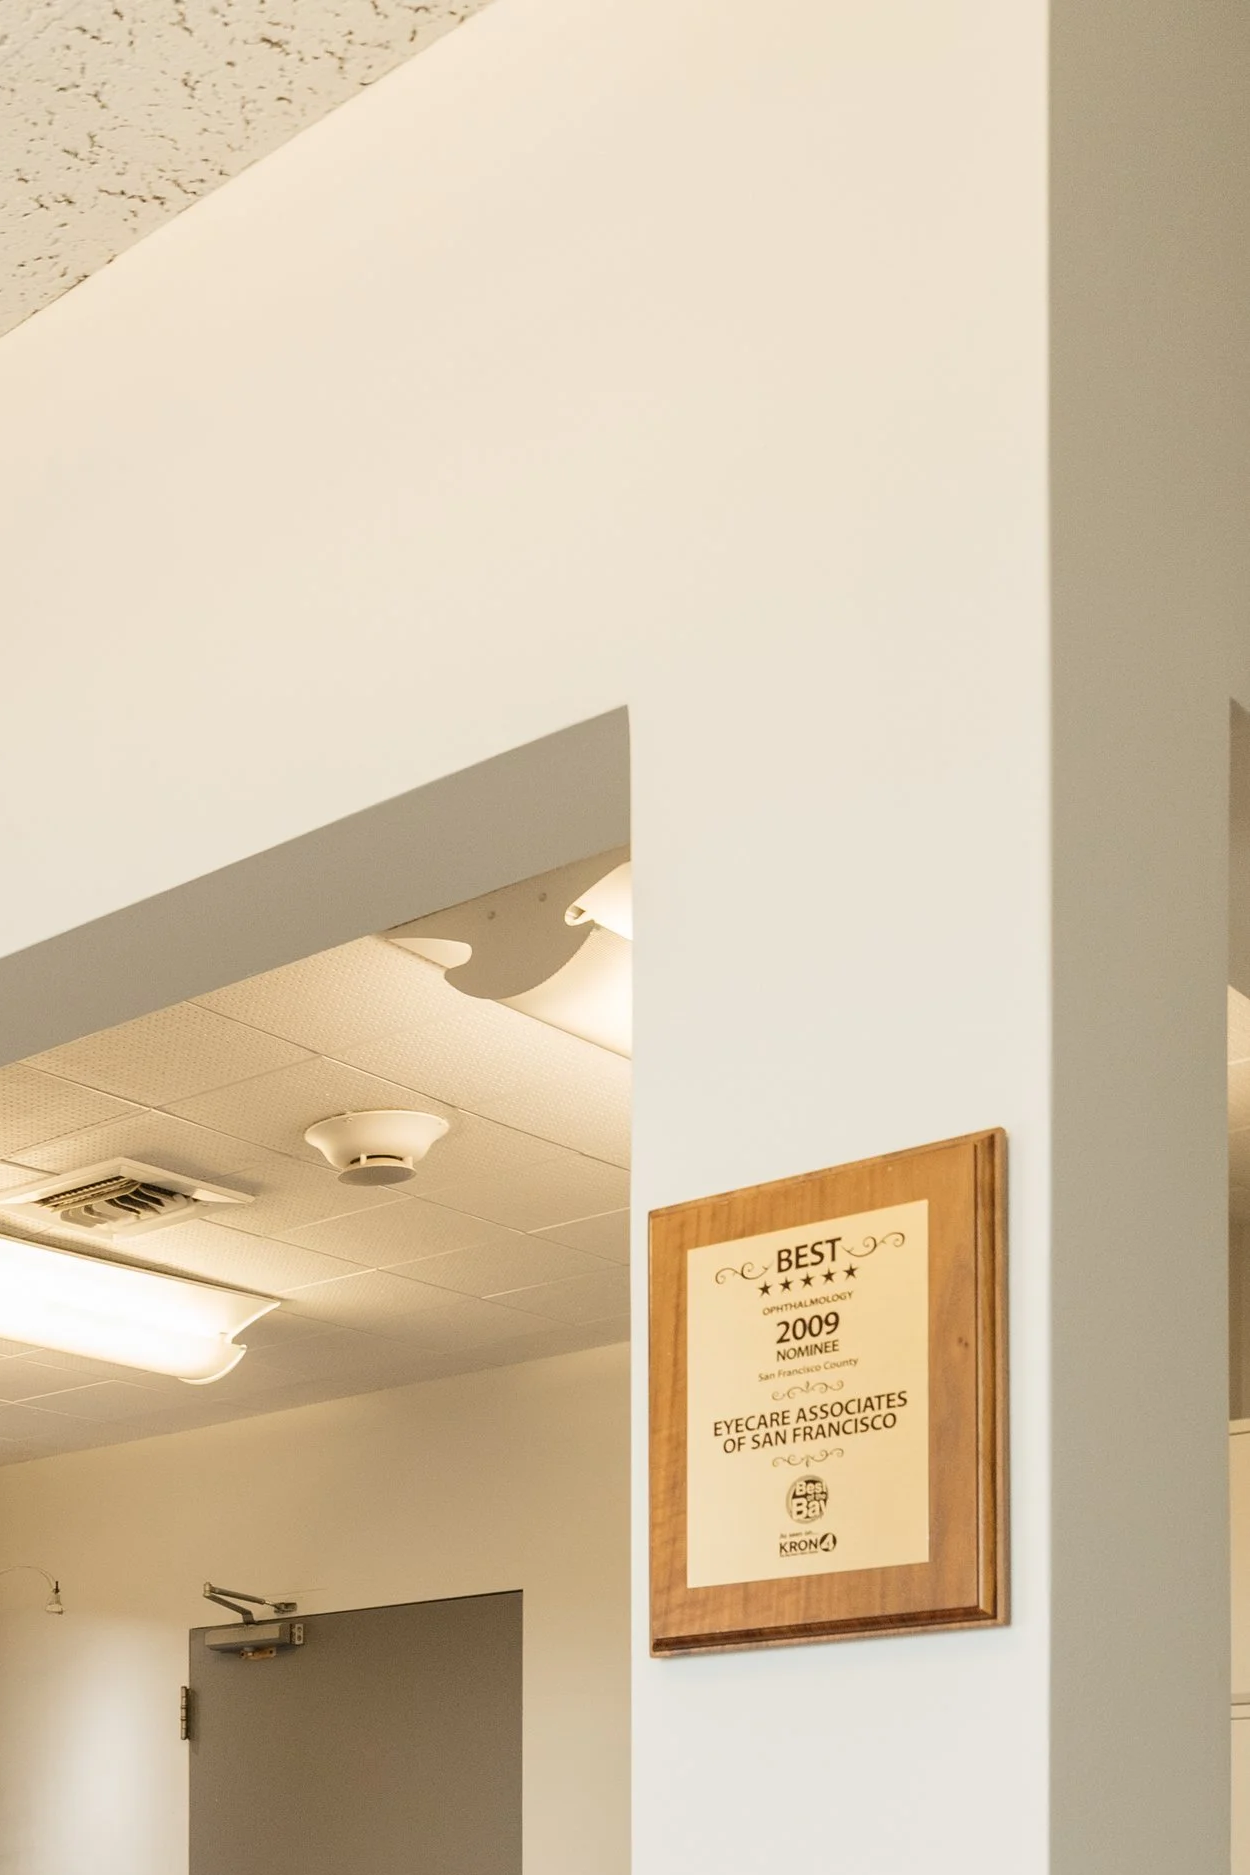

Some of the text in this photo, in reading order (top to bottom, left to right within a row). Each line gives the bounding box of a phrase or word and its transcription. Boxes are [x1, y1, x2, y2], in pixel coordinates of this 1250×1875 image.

[777, 1237, 842, 1273] BEST
[762, 1291, 854, 1316] OPHTHALMOLOGY
[776, 1311, 840, 1344] 2009
[776, 1339, 840, 1362] NOMINEE
[758, 1358, 859, 1382] San Francisco County
[713, 1391, 908, 1437] EYECARE ASSOCIATES
[723, 1413, 897, 1454] OF SAN FRANCISCO
